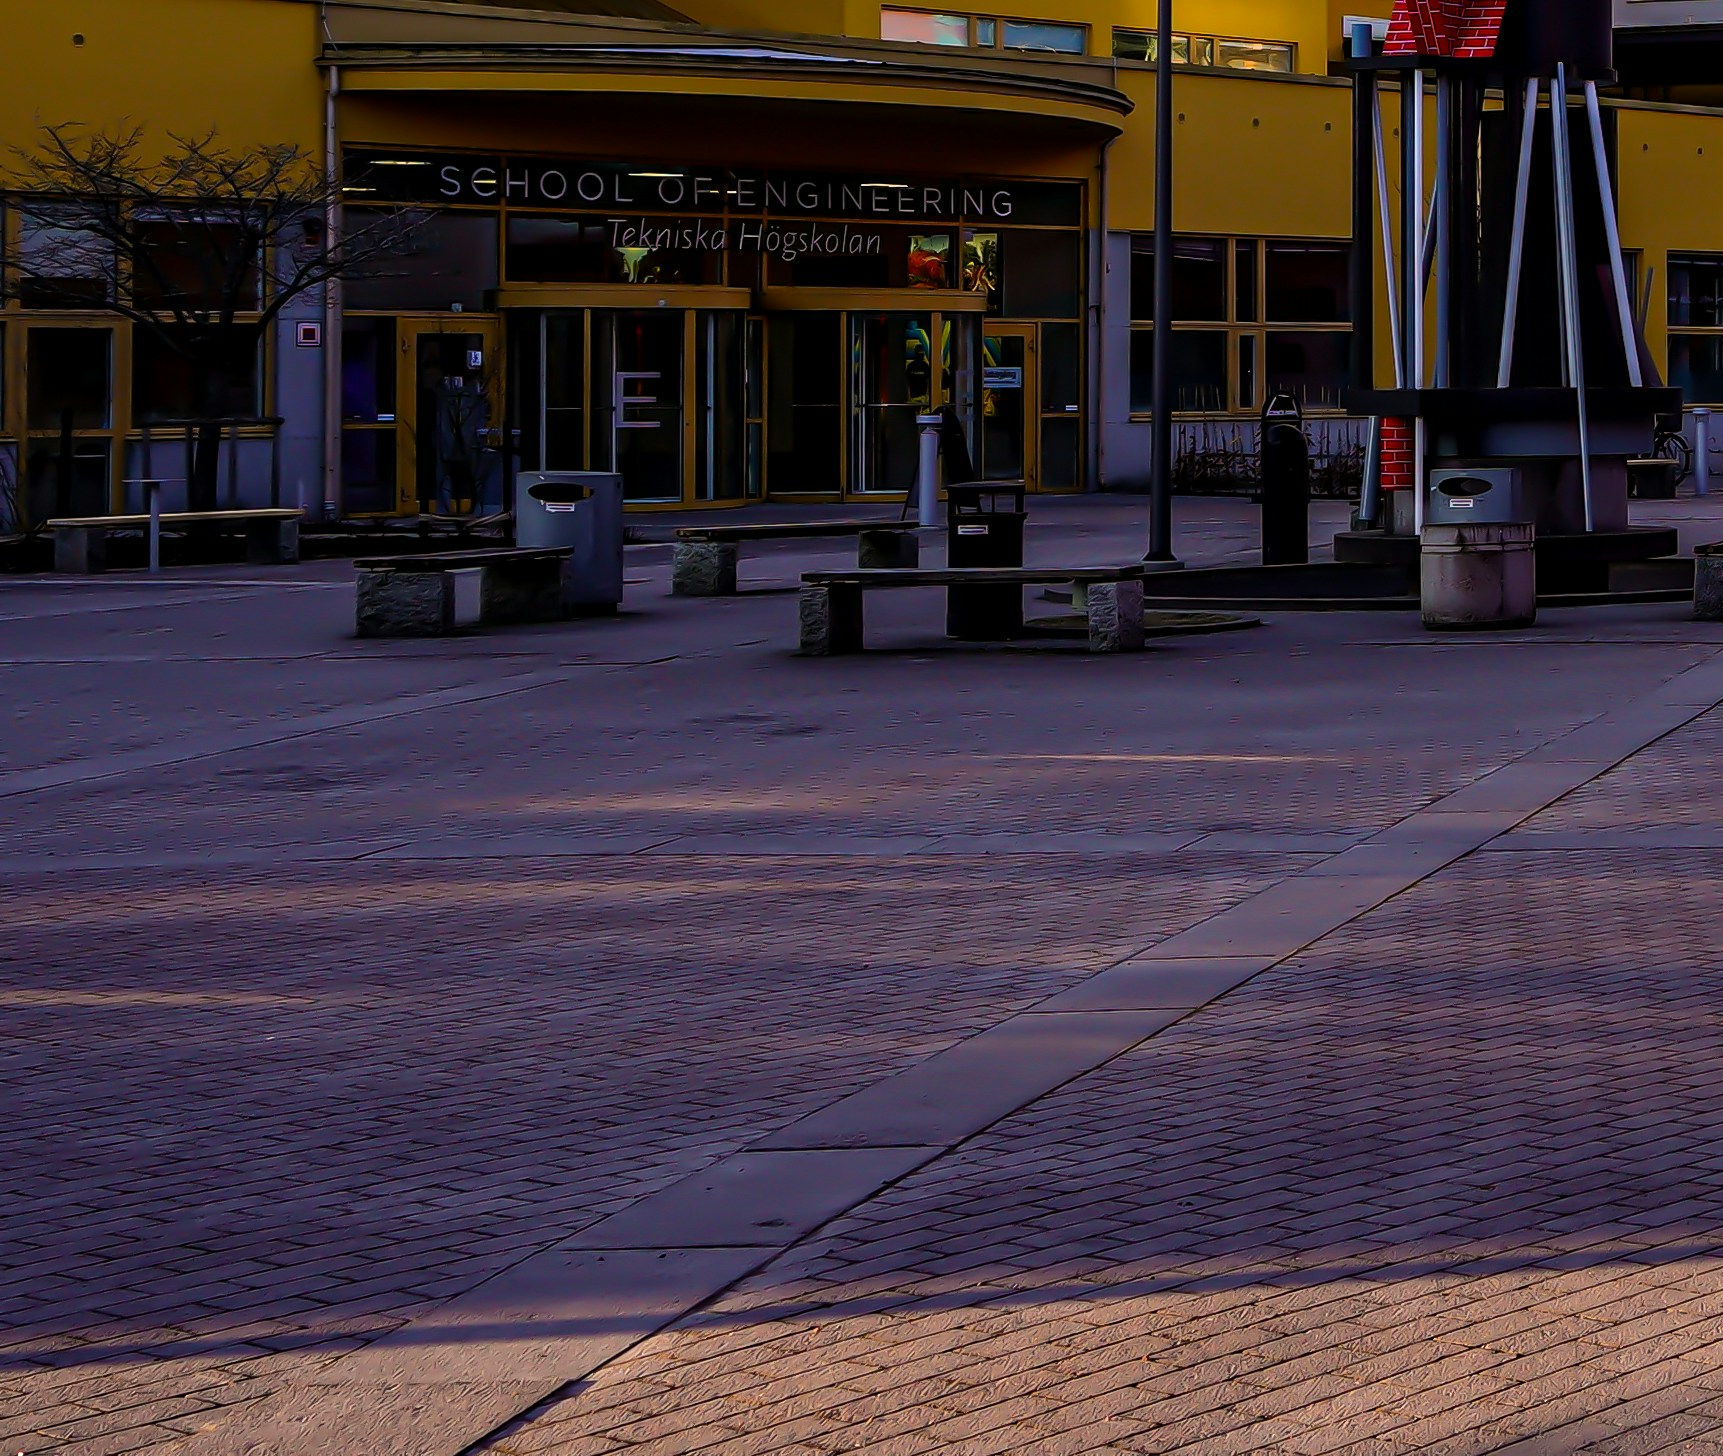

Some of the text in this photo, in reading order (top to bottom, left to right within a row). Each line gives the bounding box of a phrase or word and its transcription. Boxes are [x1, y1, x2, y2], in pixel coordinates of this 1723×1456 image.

[439, 165, 1013, 217] SCHOOL OF ENGINEERING
[607, 218, 881, 262] Tekniska Högskolan
[615, 371, 661, 429] E
